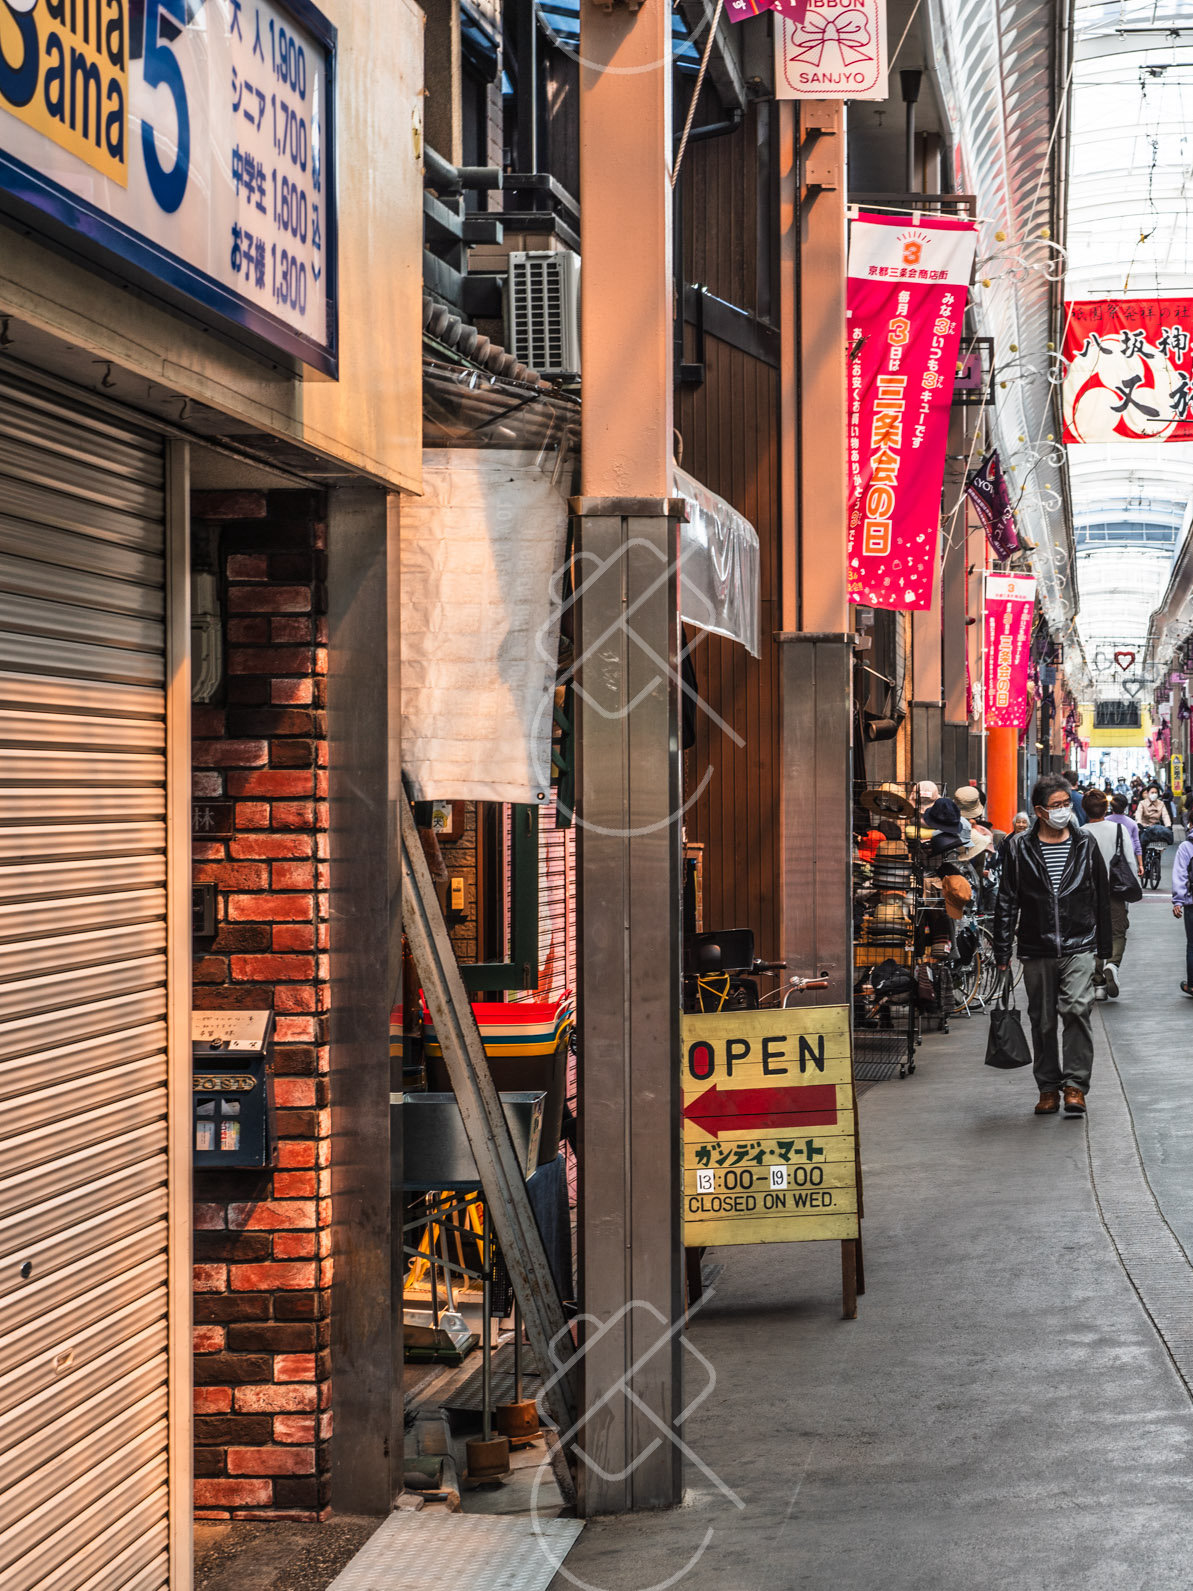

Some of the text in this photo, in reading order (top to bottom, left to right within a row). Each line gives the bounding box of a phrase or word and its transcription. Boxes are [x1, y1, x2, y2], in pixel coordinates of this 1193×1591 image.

[269, 18, 306, 101] 1,900
[799, 72, 866, 85] SANJYO
[231, 65, 307, 173] シニア 1,700
[231, 143, 307, 245] 中学生 1,600
[231, 221, 307, 316] お子様 1,300
[903, 240, 922, 266] 3
[868, 265, 949, 281] 京都三条会商店街
[688, 1034, 825, 1080] OPEN
[695, 1138, 824, 1167] ガンディ・マート
[688, 1191, 838, 1213] CLOSED ON WED.
